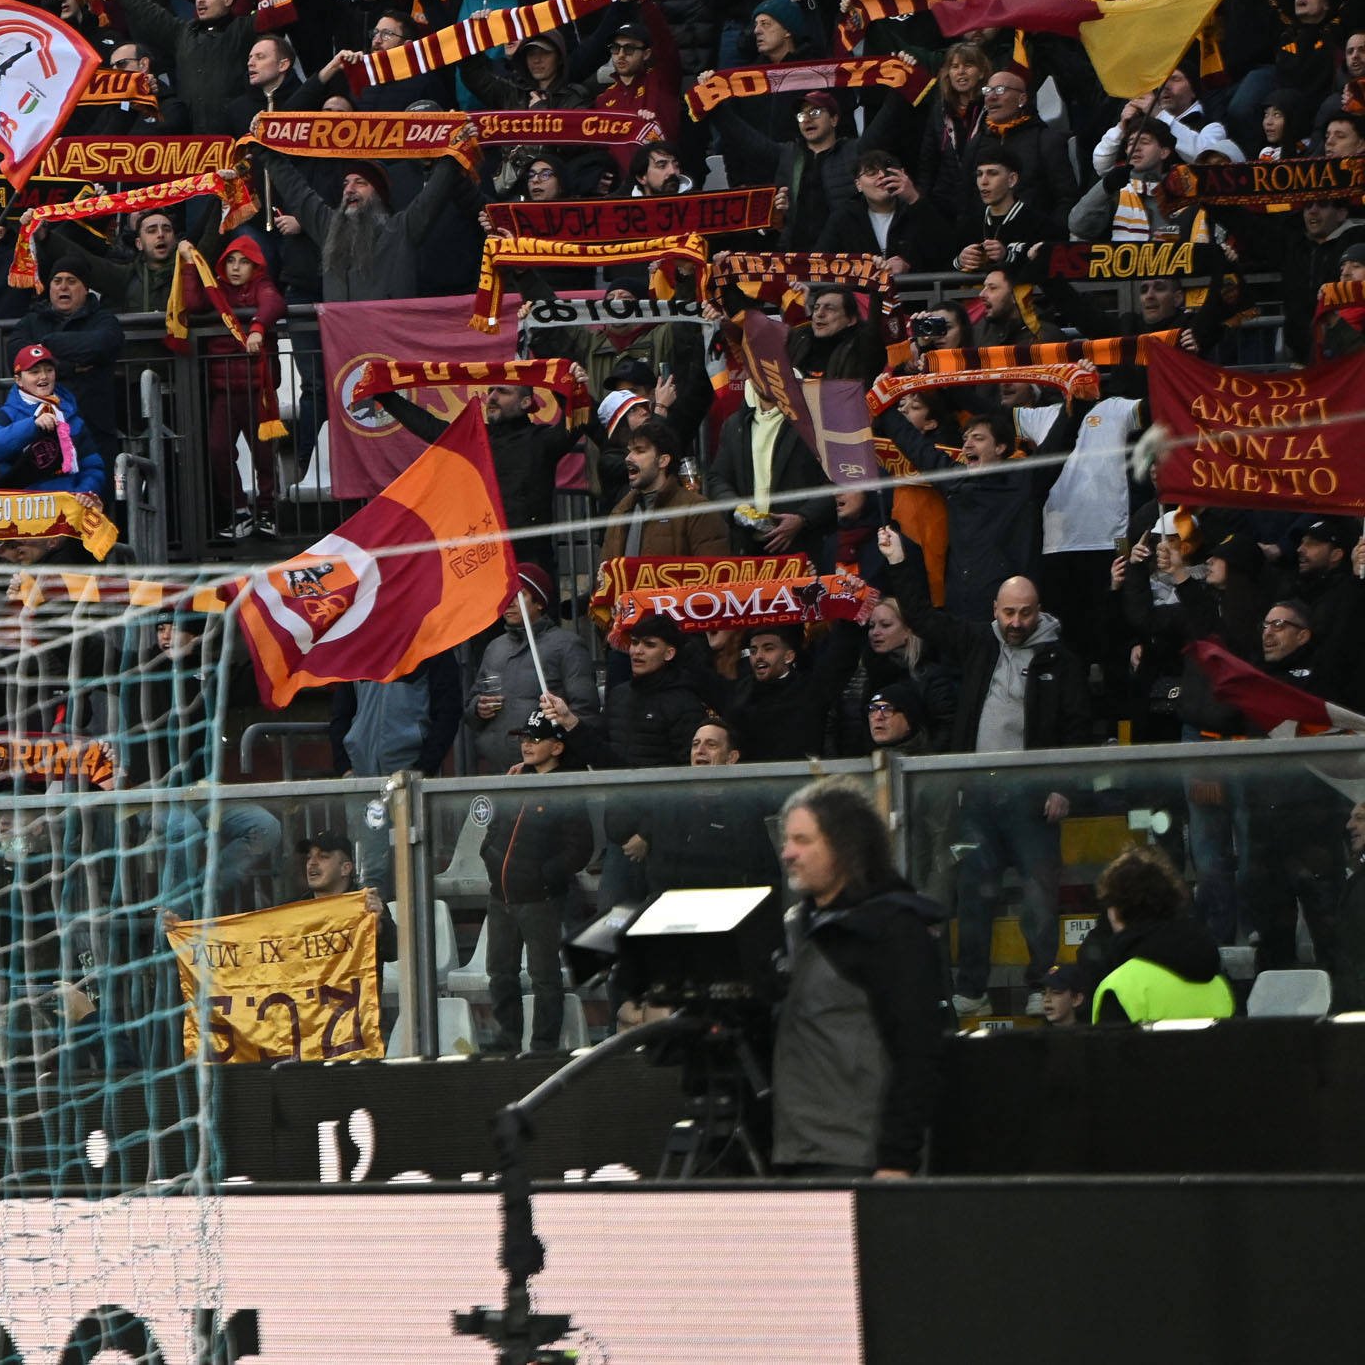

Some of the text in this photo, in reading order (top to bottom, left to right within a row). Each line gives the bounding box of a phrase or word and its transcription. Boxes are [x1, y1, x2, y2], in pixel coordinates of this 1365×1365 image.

[265, 115, 452, 149] DAJE ROMA DAJE
[481, 114, 633, 137] Vecchio Cucs
[1251, 160, 1336, 192] ROMA
[1089, 242, 1193, 278] ROMA
[1214, 373, 1309, 400] IO DI
[1190, 394, 1328, 427] AMARTI
[1194, 427, 1331, 463] NON LA
[1191, 460, 1337, 497] SMETTO
[14, 494, 56, 518] TOTTI
[653, 584, 802, 619] ROMA
[11, 738, 99, 773] ROMA
